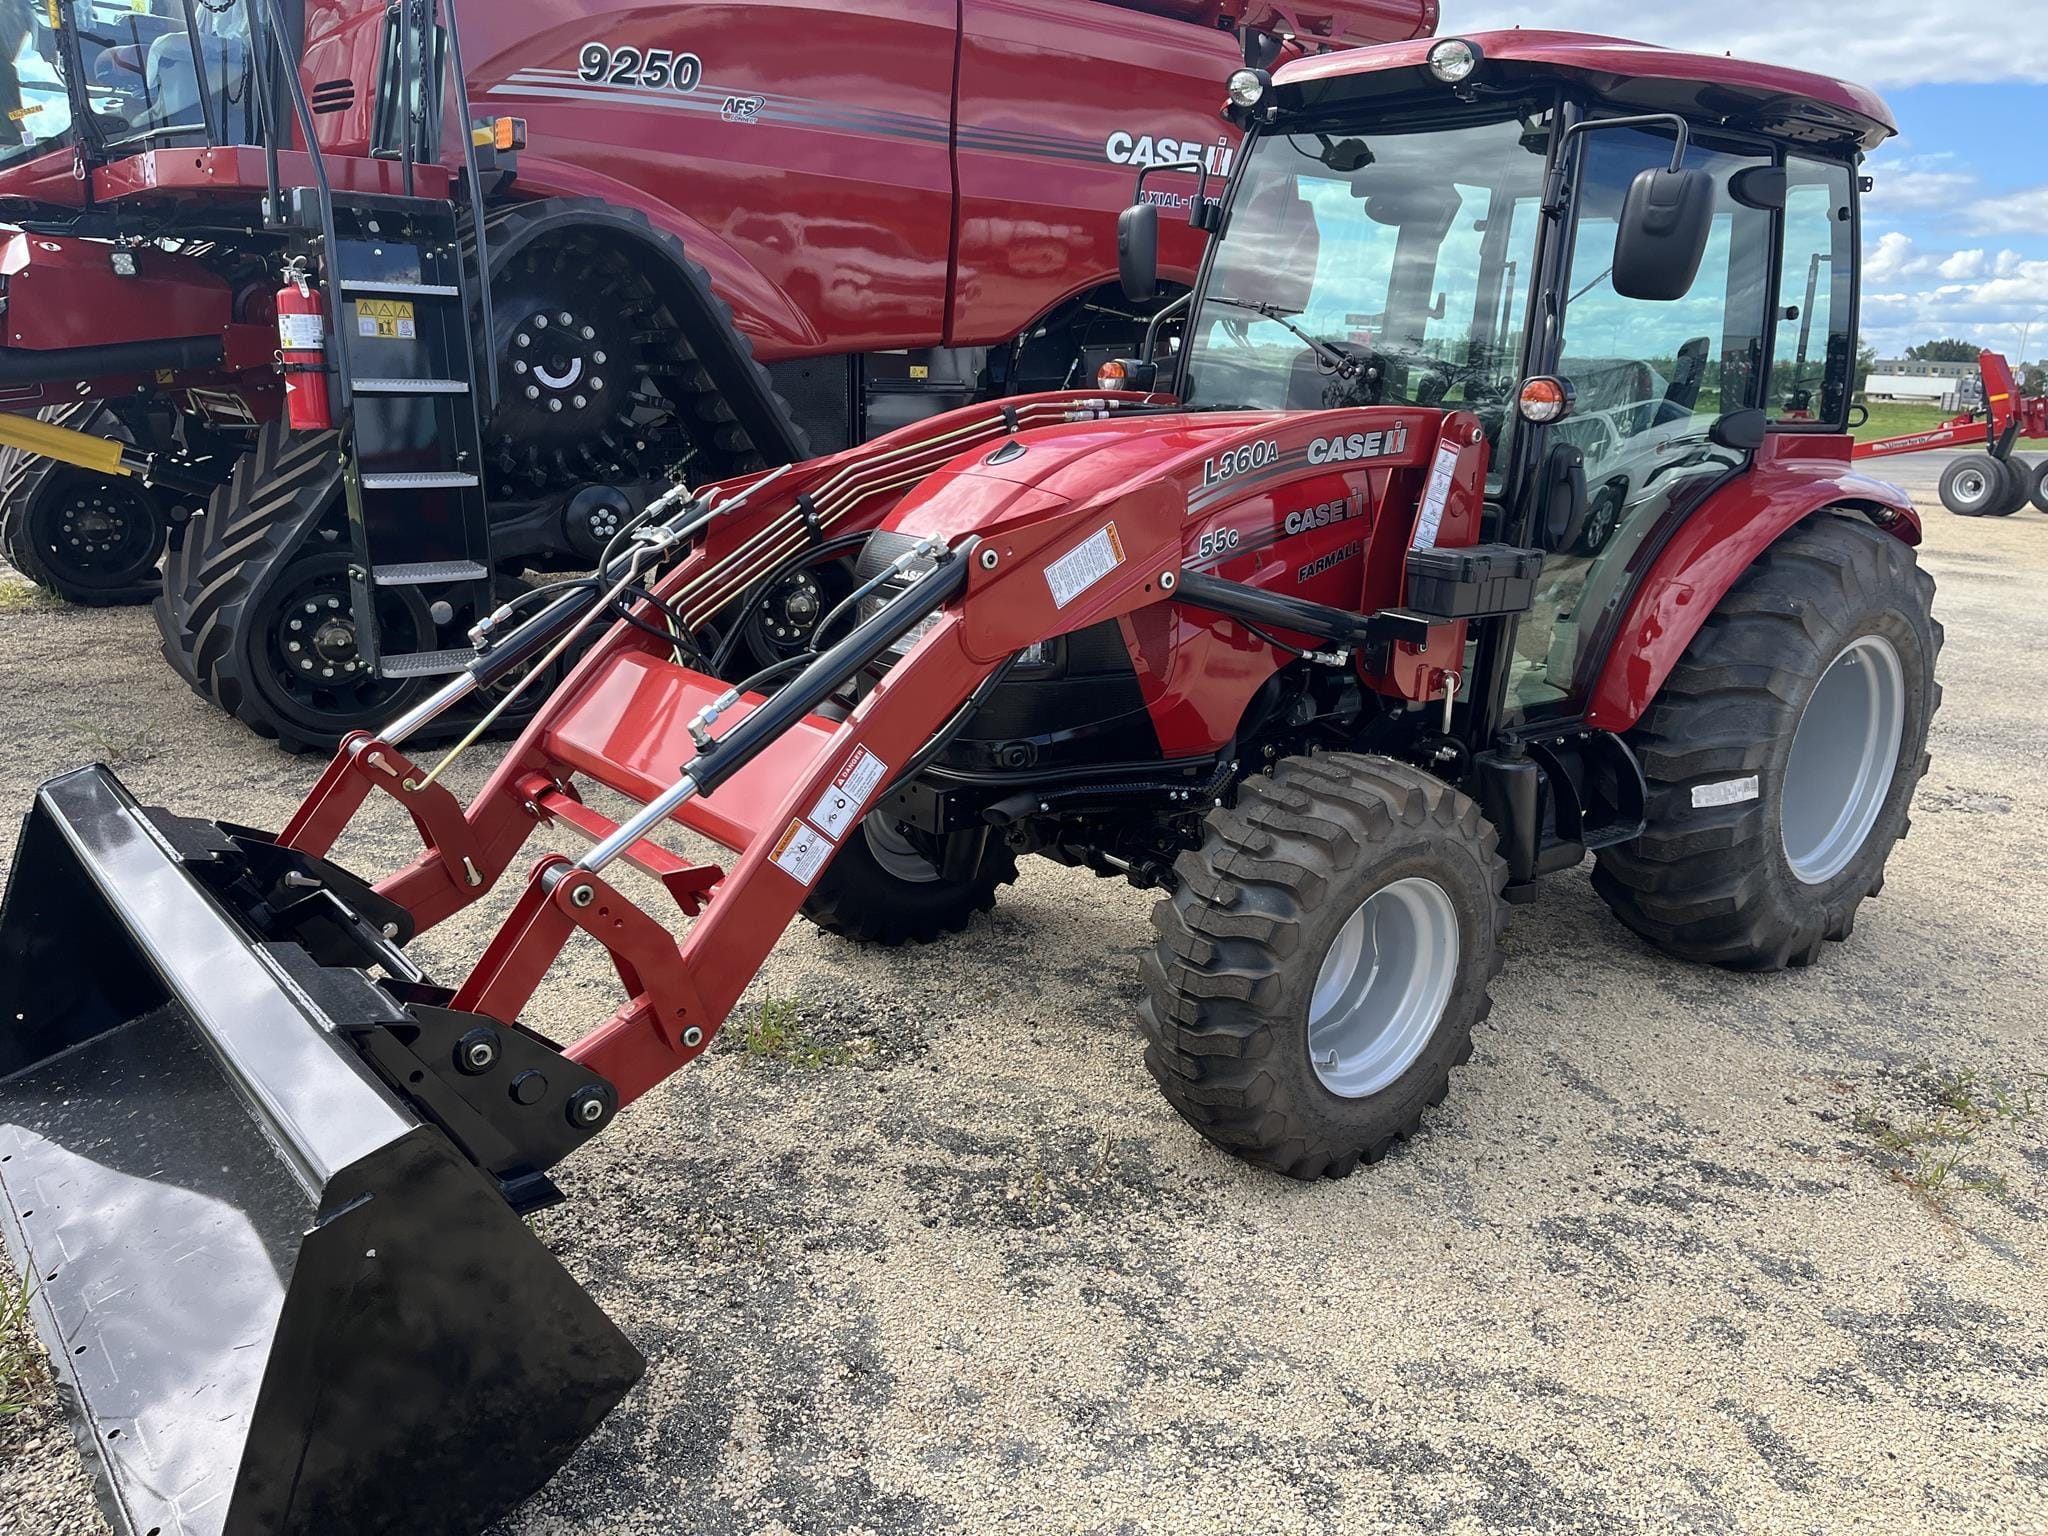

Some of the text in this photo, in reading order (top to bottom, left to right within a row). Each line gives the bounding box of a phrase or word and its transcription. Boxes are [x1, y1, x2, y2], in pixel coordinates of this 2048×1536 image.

[578, 42, 701, 93] 9250
[720, 96, 757, 116] AFS
[1106, 131, 1202, 173] CASE
[1203, 440, 1279, 488] L360A
[1307, 431, 1383, 465] CASE
[1284, 499, 1344, 535] CASE
[1298, 541, 1360, 584] FARMALL
[842, 749, 864, 778] DANGER
